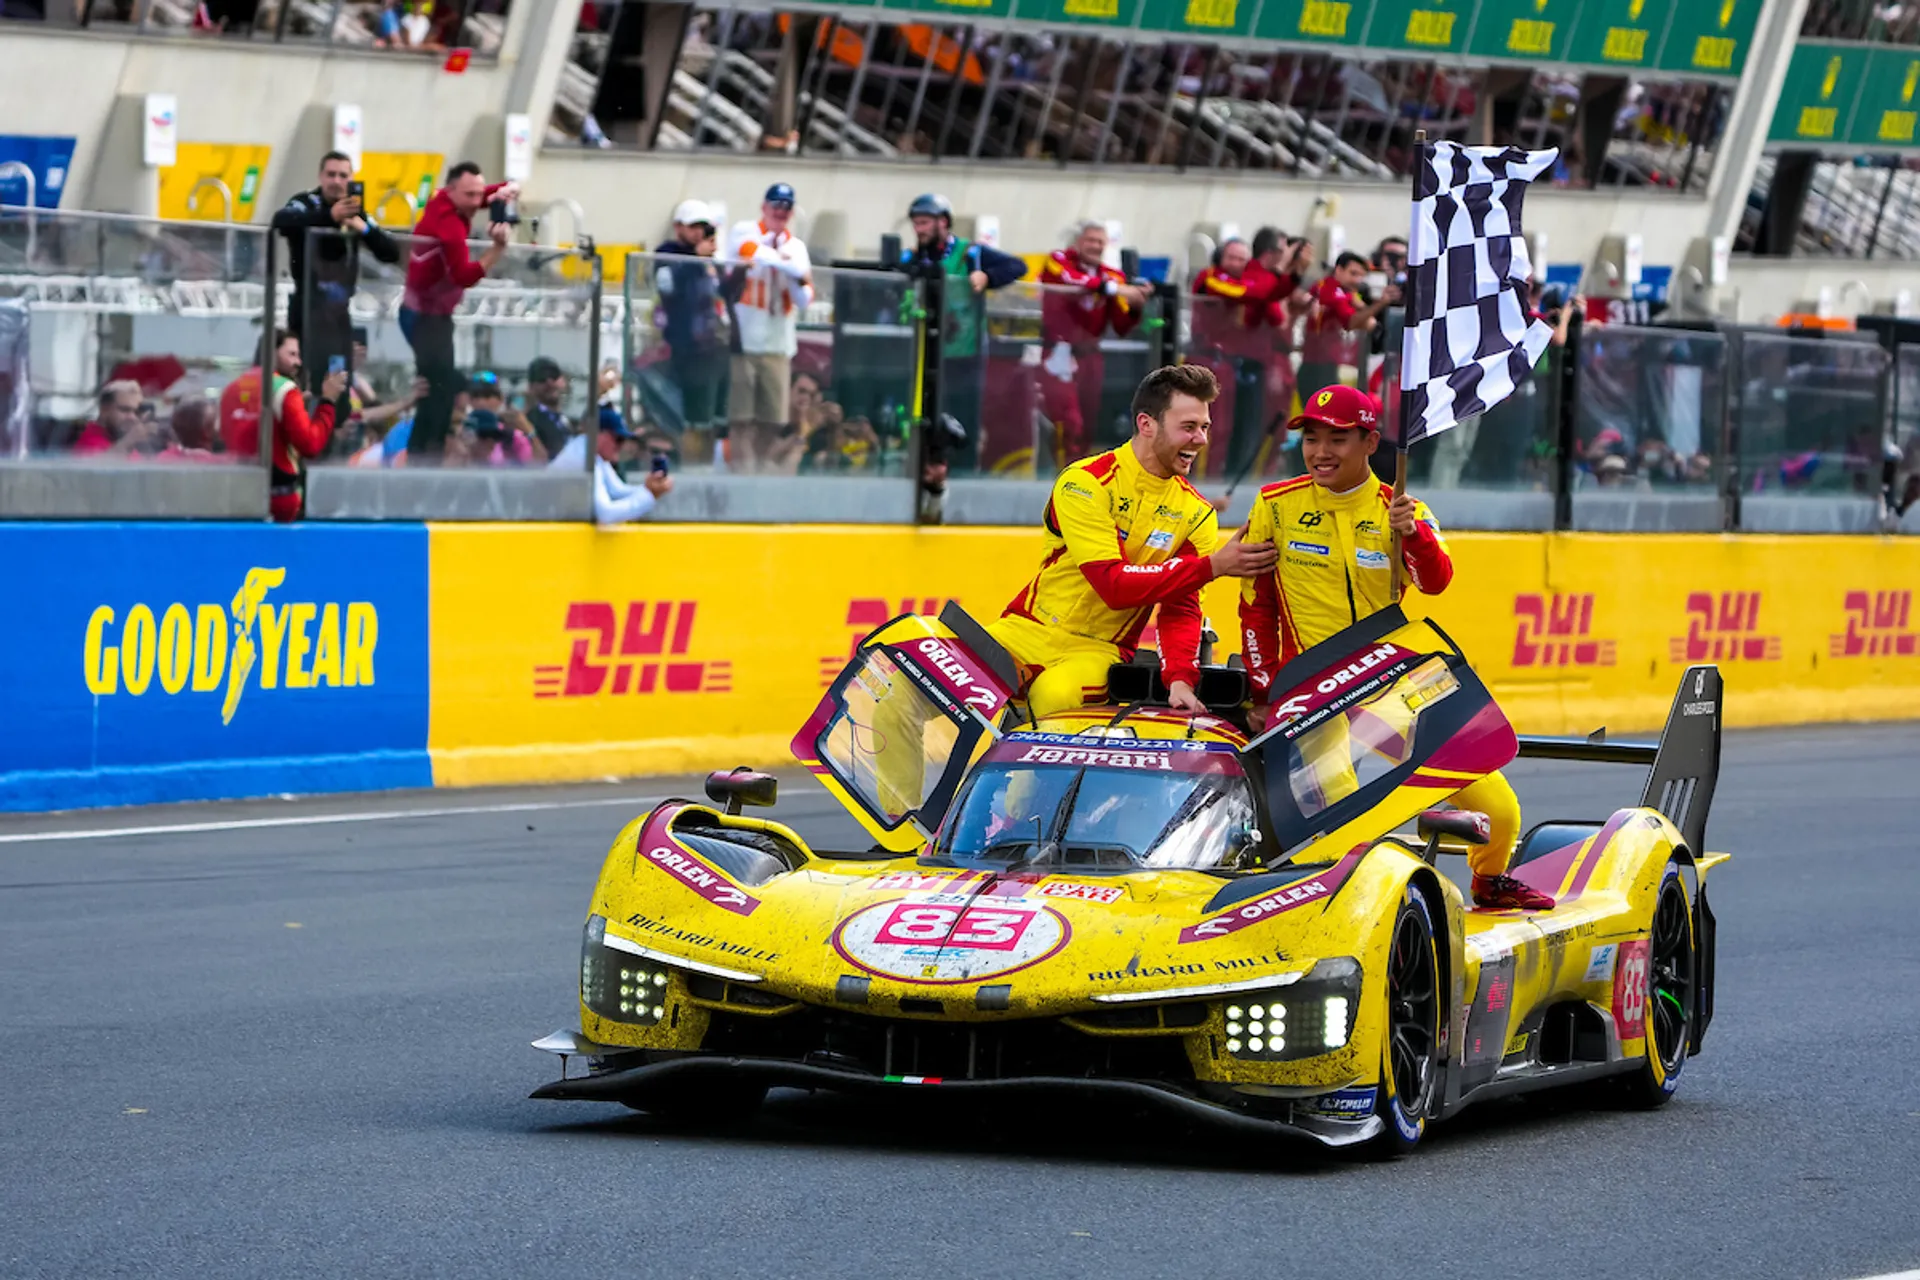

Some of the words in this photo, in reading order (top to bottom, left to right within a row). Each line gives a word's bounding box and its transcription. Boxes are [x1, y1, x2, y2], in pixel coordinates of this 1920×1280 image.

[1511, 593, 1597, 668] DHL
[1685, 591, 1762, 662] DHL
[1843, 590, 1913, 657] DHL
[563, 600, 703, 698] DHL
[918, 639, 975, 687] ORLEN
[1316, 643, 1398, 694] ORLEN
[1017, 745, 1174, 770] Ferrari
[1103, 737, 1173, 749] POZZI
[649, 847, 718, 887] ORLEN
[1240, 881, 1329, 919] ORLEN
[626, 913, 714, 947] RICHARD
[712, 941, 784, 964] MILLE
[887, 908, 1025, 943] 83
[1088, 963, 1206, 982] RICHARD
[1213, 950, 1294, 971] MILLE
[1622, 957, 1645, 1023] 83
